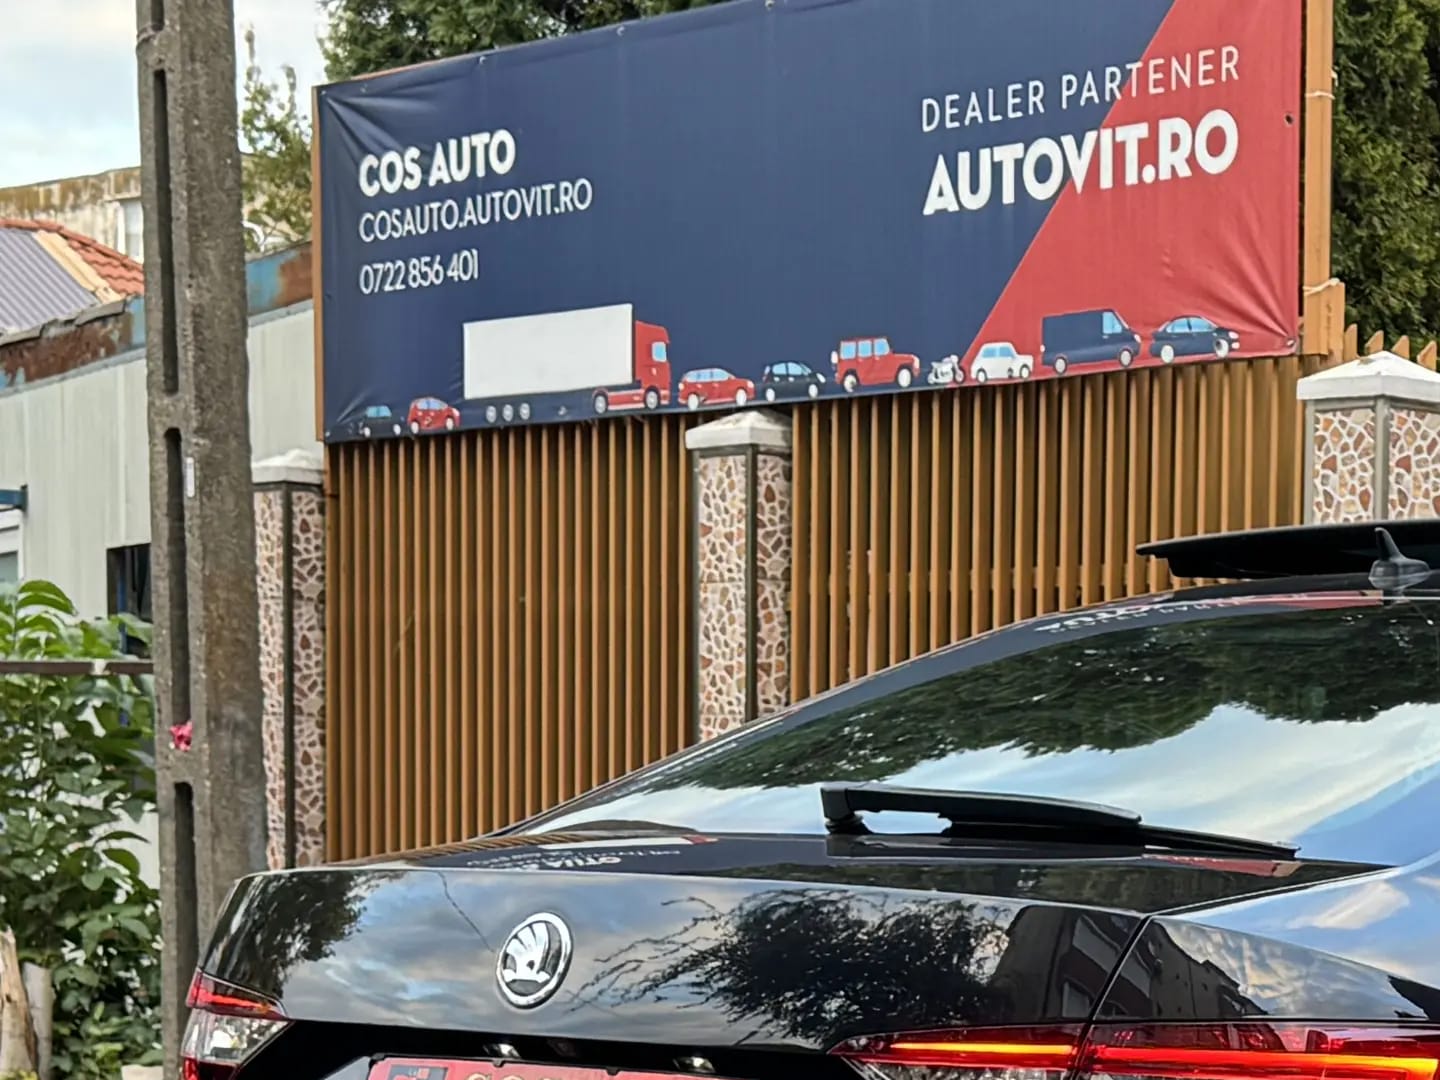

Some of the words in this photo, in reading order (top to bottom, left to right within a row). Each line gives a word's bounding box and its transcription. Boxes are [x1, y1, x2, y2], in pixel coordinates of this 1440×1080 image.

[922, 80, 1045, 132] DEALER
[1061, 45, 1240, 110] PARTENER
[358, 146, 422, 197] COS
[428, 128, 516, 187] AUTO
[922, 108, 1239, 216] AUTOVIT.RO
[358, 178, 593, 242] COSAUTO.AUTOVIT.RO
[359, 260, 405, 294] 0722
[408, 255, 444, 288] 856
[447, 248, 479, 282] 401
